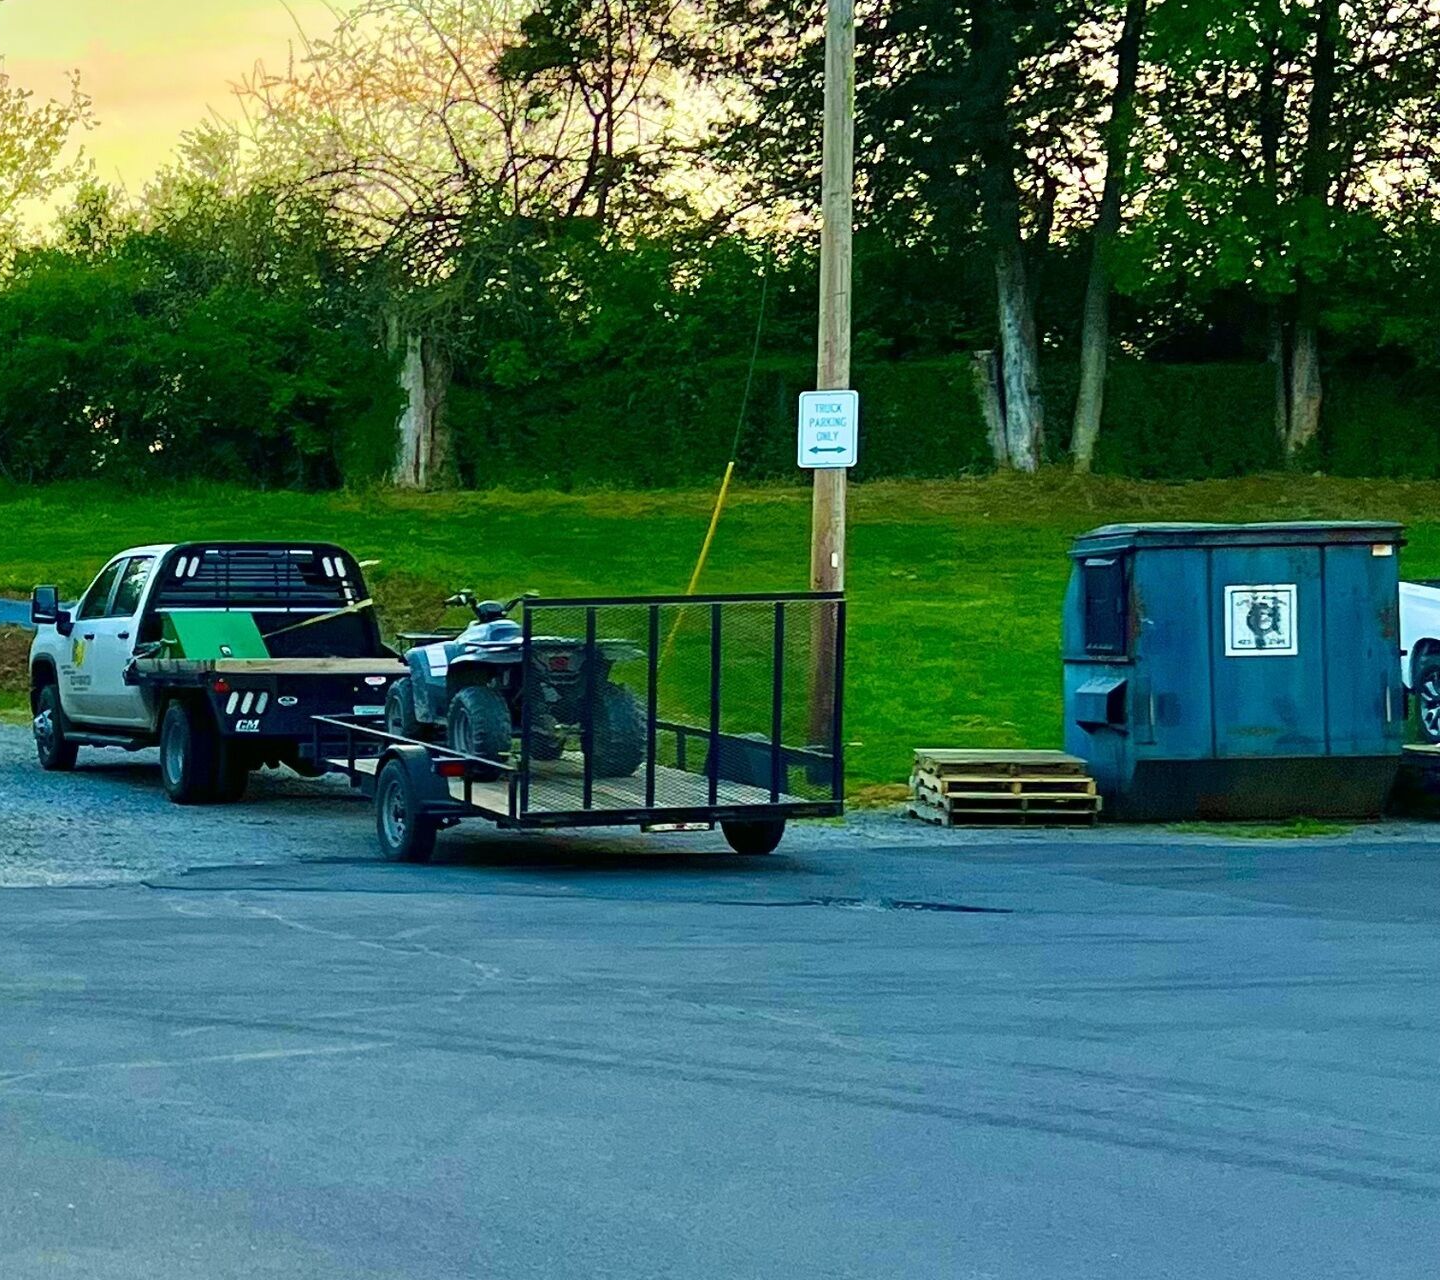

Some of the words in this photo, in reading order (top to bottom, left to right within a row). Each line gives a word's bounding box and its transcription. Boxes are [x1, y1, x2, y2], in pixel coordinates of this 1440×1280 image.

[815, 403, 842, 413] TRUCK
[809, 416, 847, 428] PARKING
[816, 431, 839, 441] ONLY
